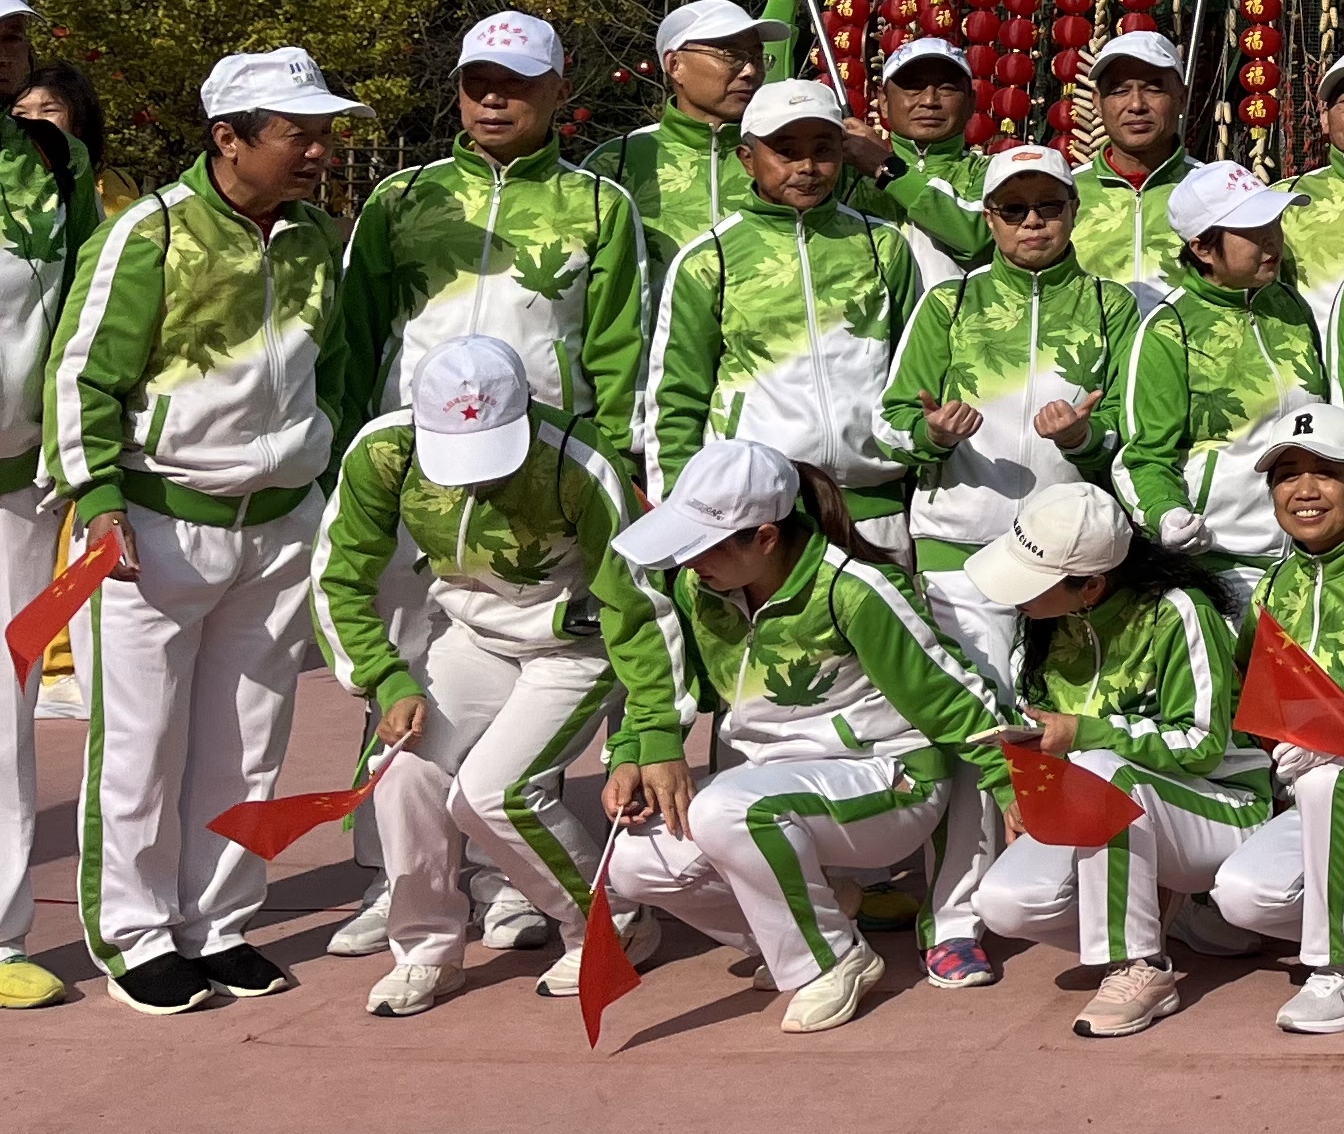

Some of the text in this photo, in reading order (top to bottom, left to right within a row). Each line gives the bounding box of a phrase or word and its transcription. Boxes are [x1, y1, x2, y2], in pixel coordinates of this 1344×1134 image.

[836, 0, 853, 16] 福
[834, 32, 850, 49] 福
[1245, 31, 1263, 50] 福
[1246, 65, 1265, 85] 福
[1247, 99, 1266, 119] 福
[1293, 413, 1313, 437] R
